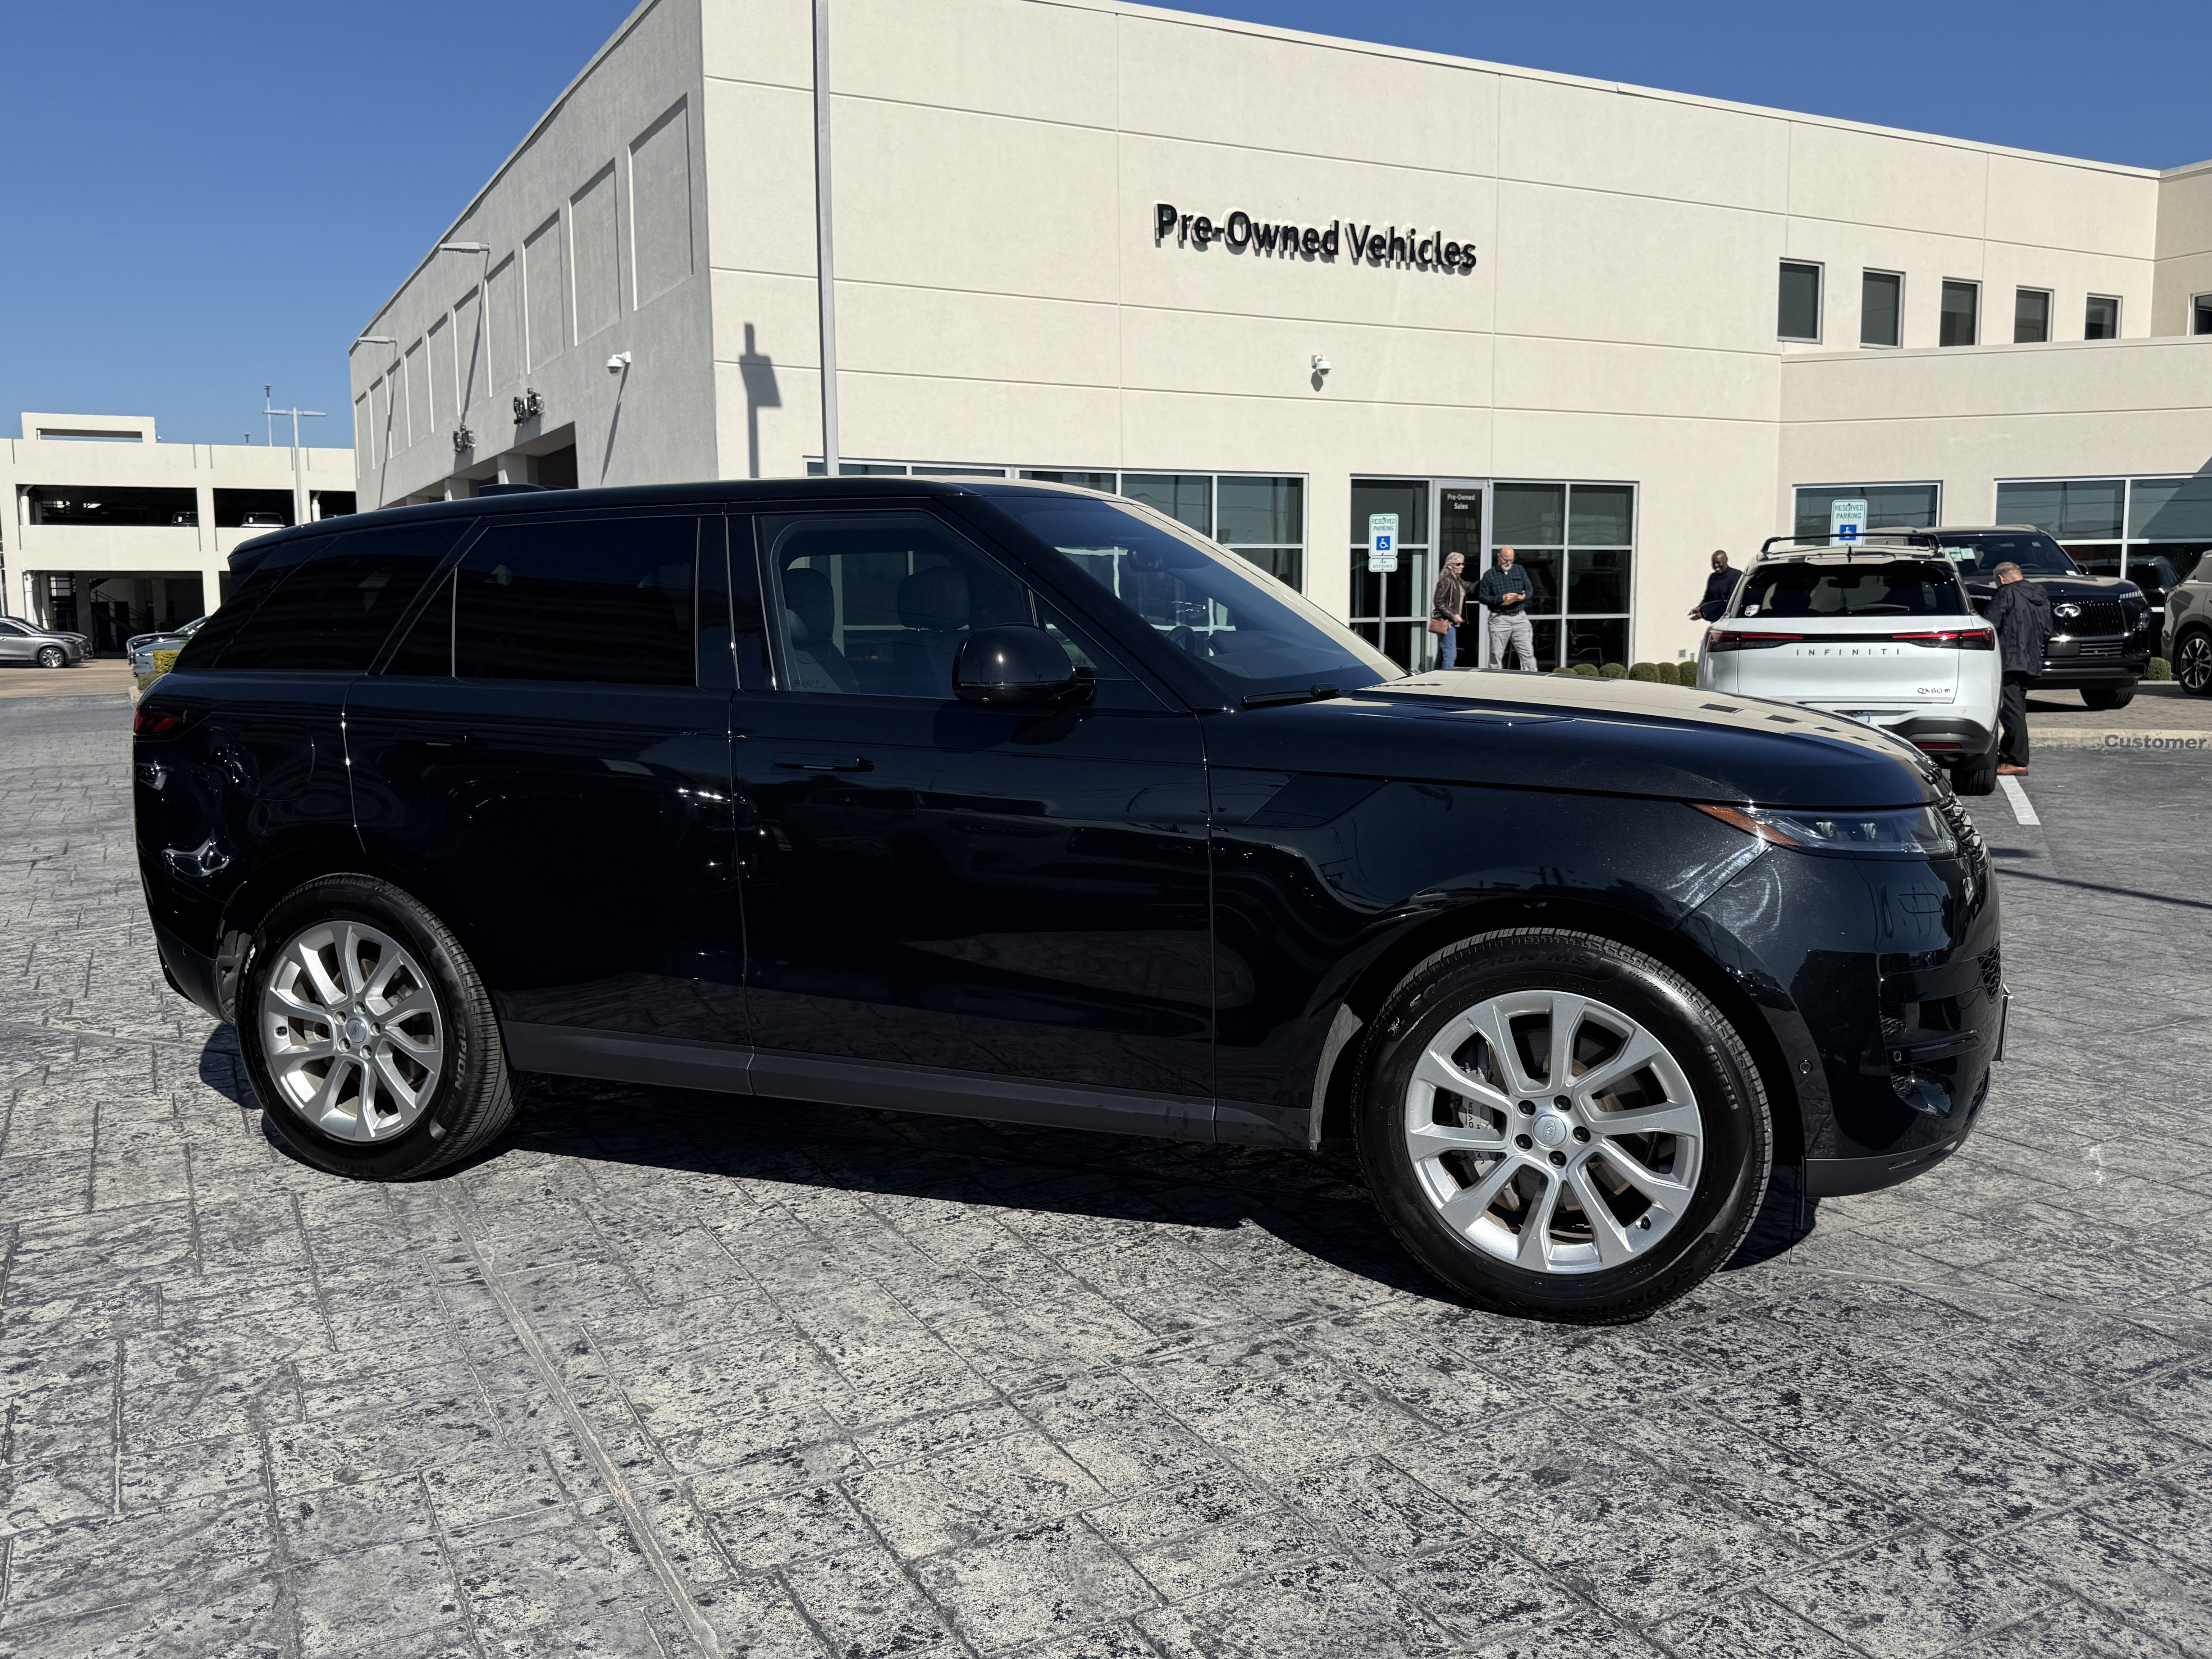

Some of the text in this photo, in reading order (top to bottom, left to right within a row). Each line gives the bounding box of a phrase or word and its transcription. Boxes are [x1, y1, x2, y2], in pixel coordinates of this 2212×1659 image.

[1154, 203, 1477, 269] Pre-Owned Vehicles
[2104, 734, 2207, 749] Customer
